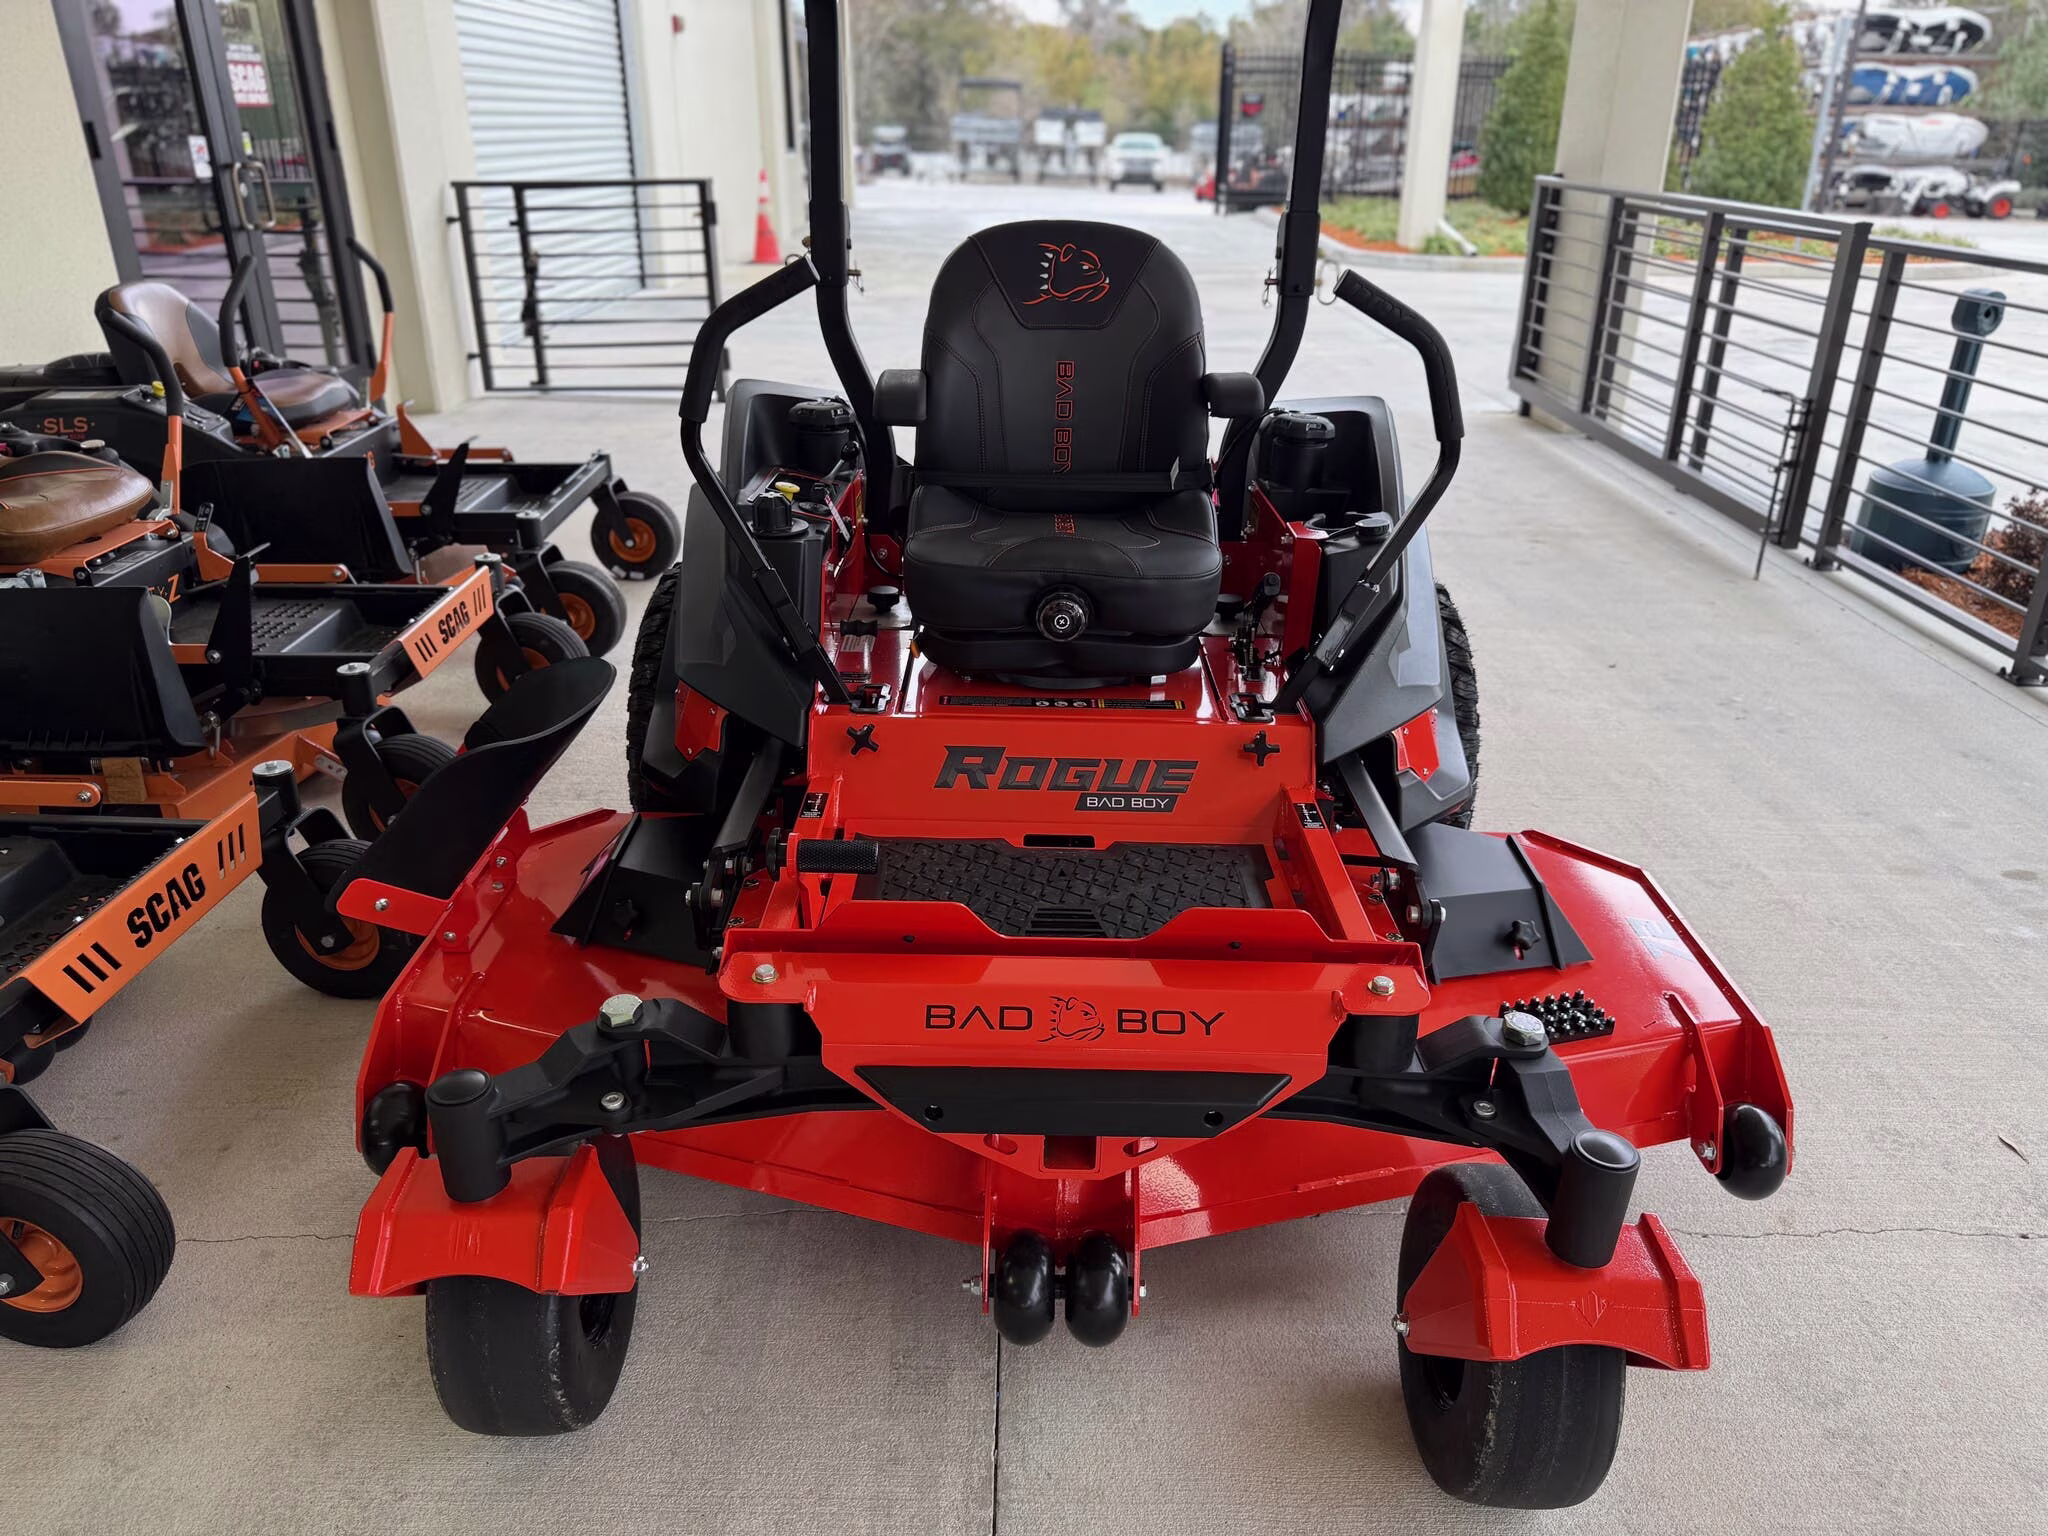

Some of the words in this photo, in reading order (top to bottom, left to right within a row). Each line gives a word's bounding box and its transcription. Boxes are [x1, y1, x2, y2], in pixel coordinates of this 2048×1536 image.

[1056, 360, 1075, 420] BAD
[44, 416, 88, 434] SLS
[438, 600, 470, 645] SCAG
[1086, 796, 1125, 808] BAD
[1131, 797, 1169, 809] BOY
[126, 862, 206, 949] SCAG
[925, 1004, 1033, 1031] BAD
[1117, 1008, 1225, 1036] BOY
